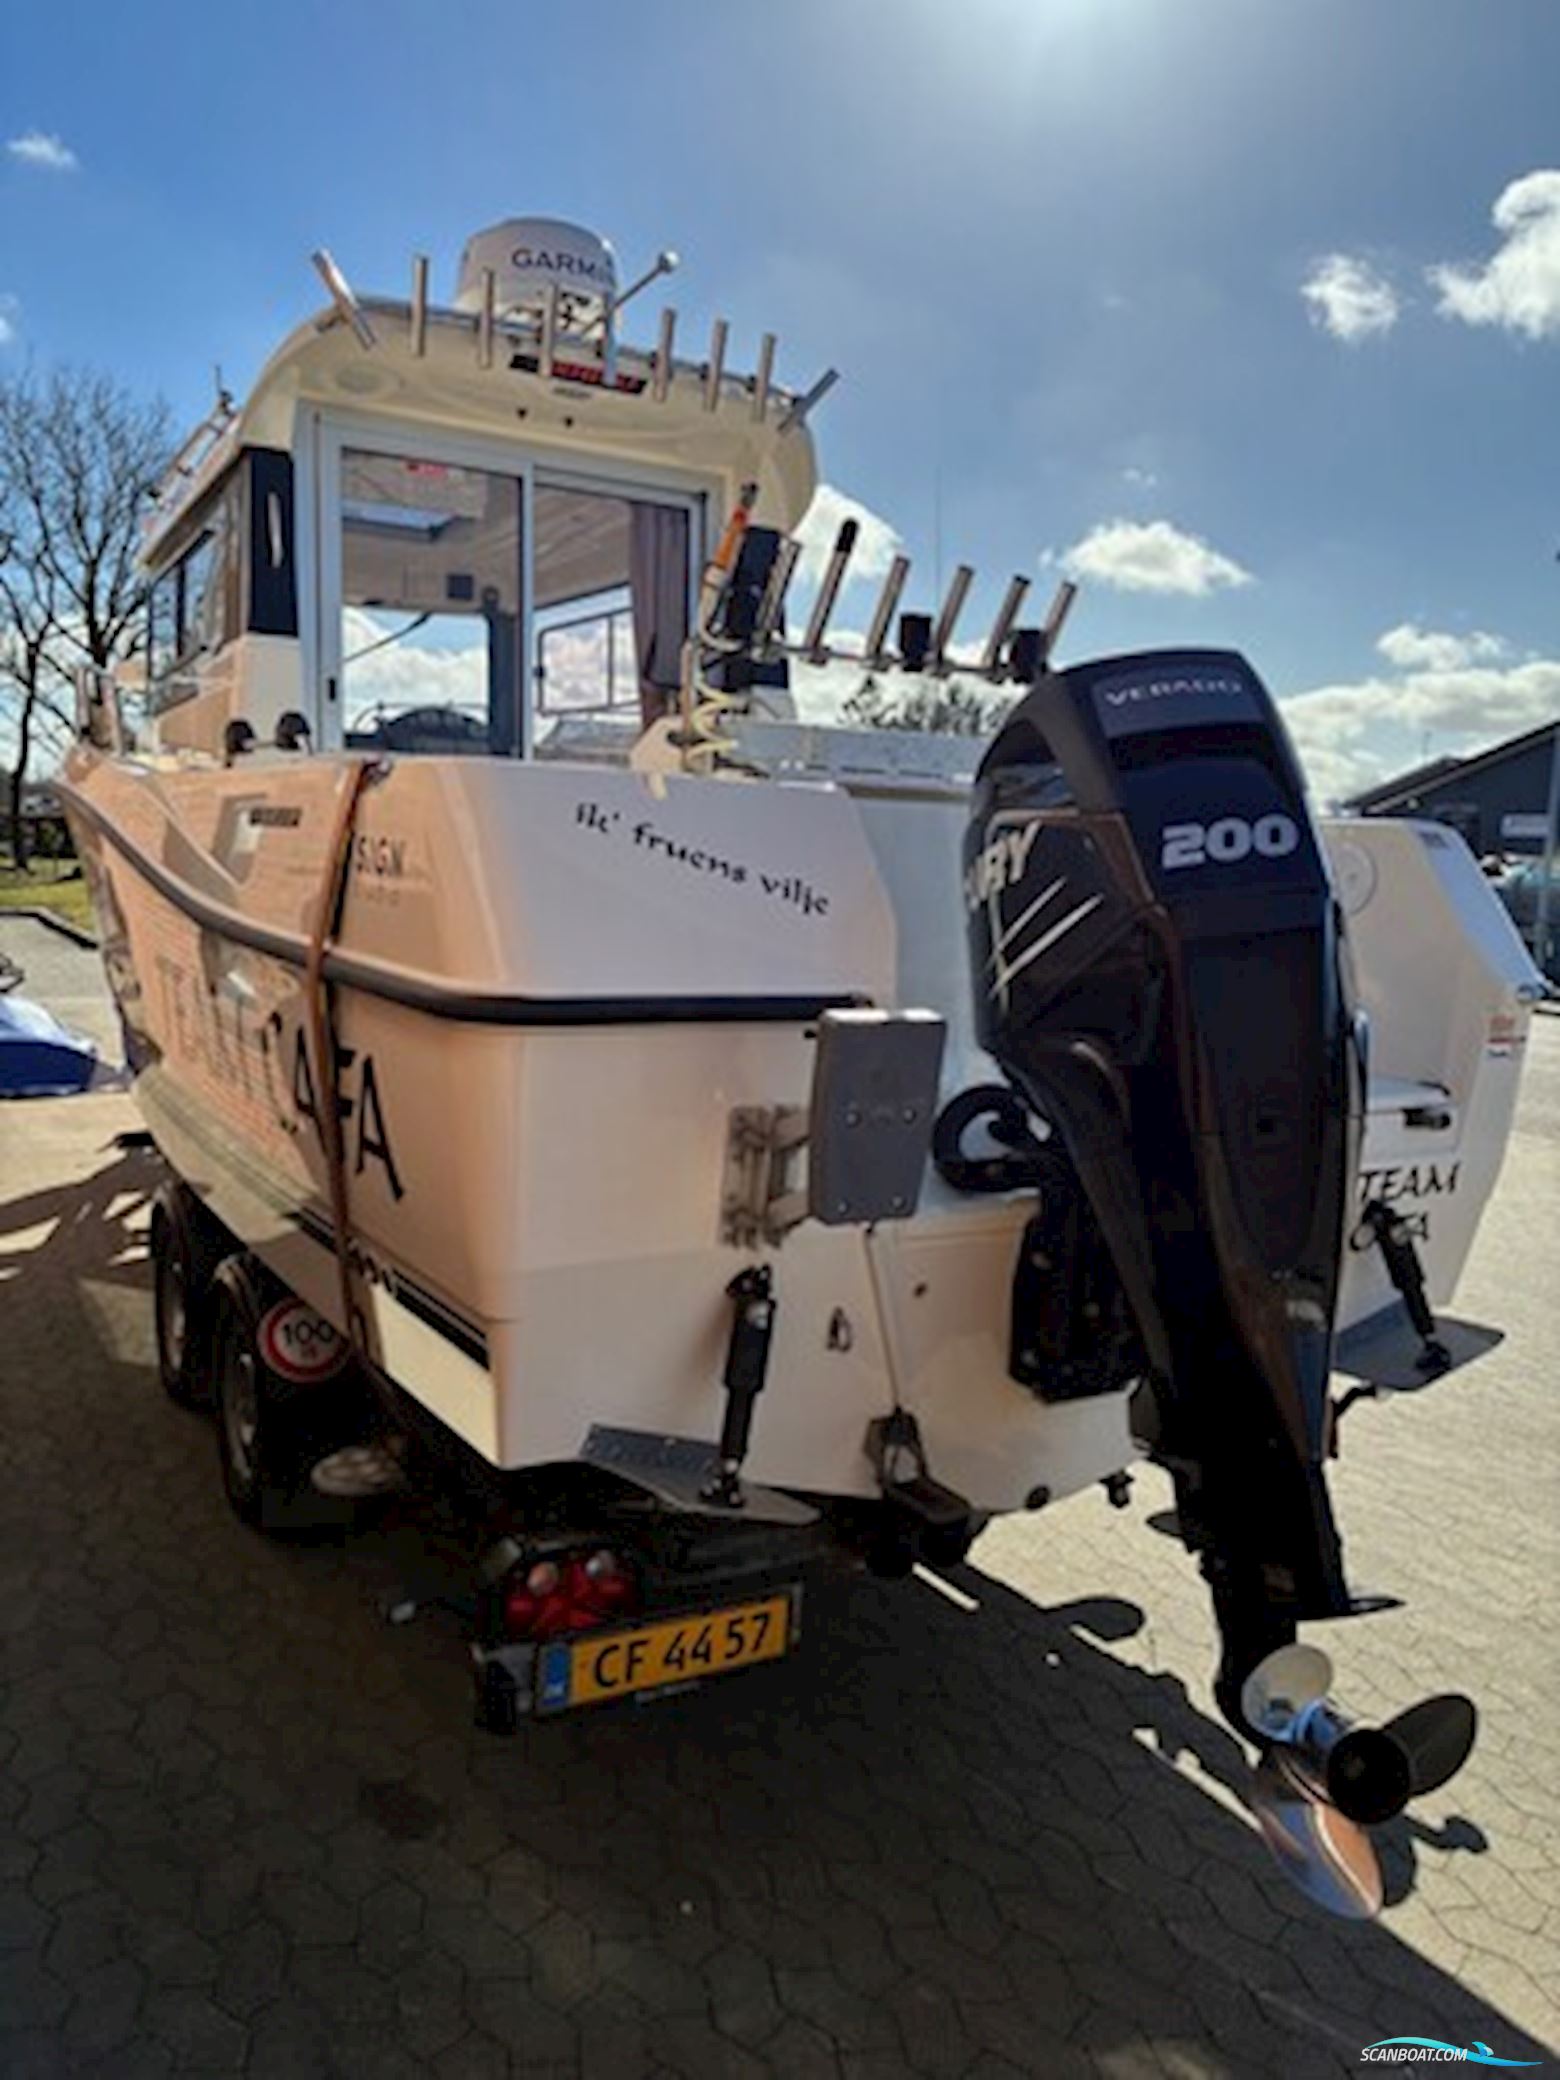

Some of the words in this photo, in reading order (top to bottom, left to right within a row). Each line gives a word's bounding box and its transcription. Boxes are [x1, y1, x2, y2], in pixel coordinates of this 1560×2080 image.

[1104, 678, 1243, 706] VERADO
[1161, 812, 1299, 870] 200
[633, 822, 748, 884] fruens
[759, 873, 830, 916] vilje
[1358, 1159, 1461, 1202] TEAM
[593, 1638, 650, 1689] CF
